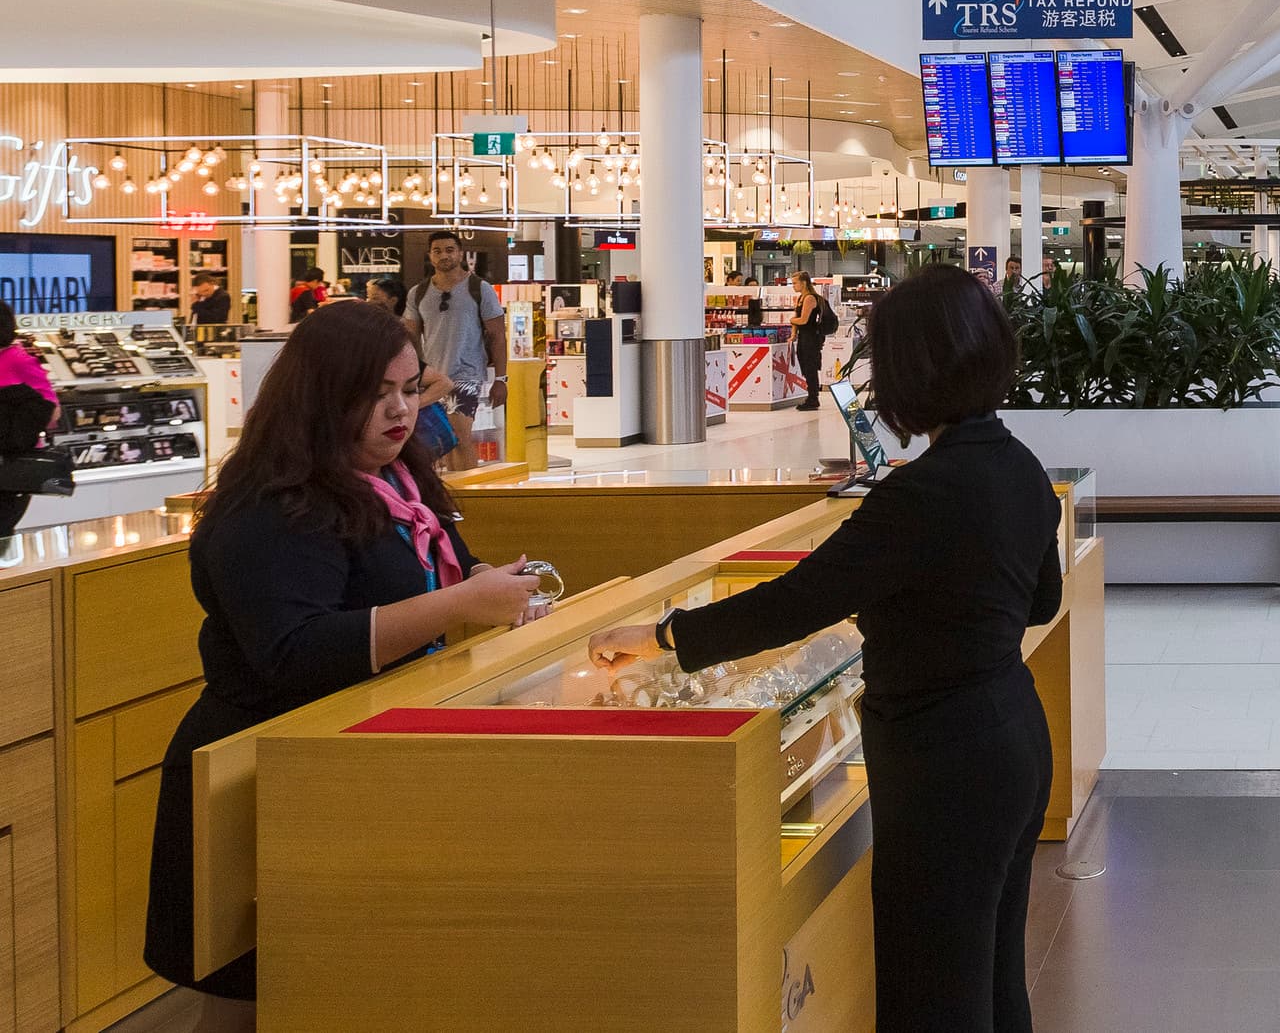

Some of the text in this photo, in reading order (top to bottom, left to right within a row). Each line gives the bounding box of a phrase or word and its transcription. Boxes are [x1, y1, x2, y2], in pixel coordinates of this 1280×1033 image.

[956, 3, 1018, 26] TRS
[1041, 9, 1116, 28] 游客退税
[962, 26, 979, 34] Tourist
[341, 247, 400, 267] NARS
[18, 313, 126, 328] GIVENCHY
